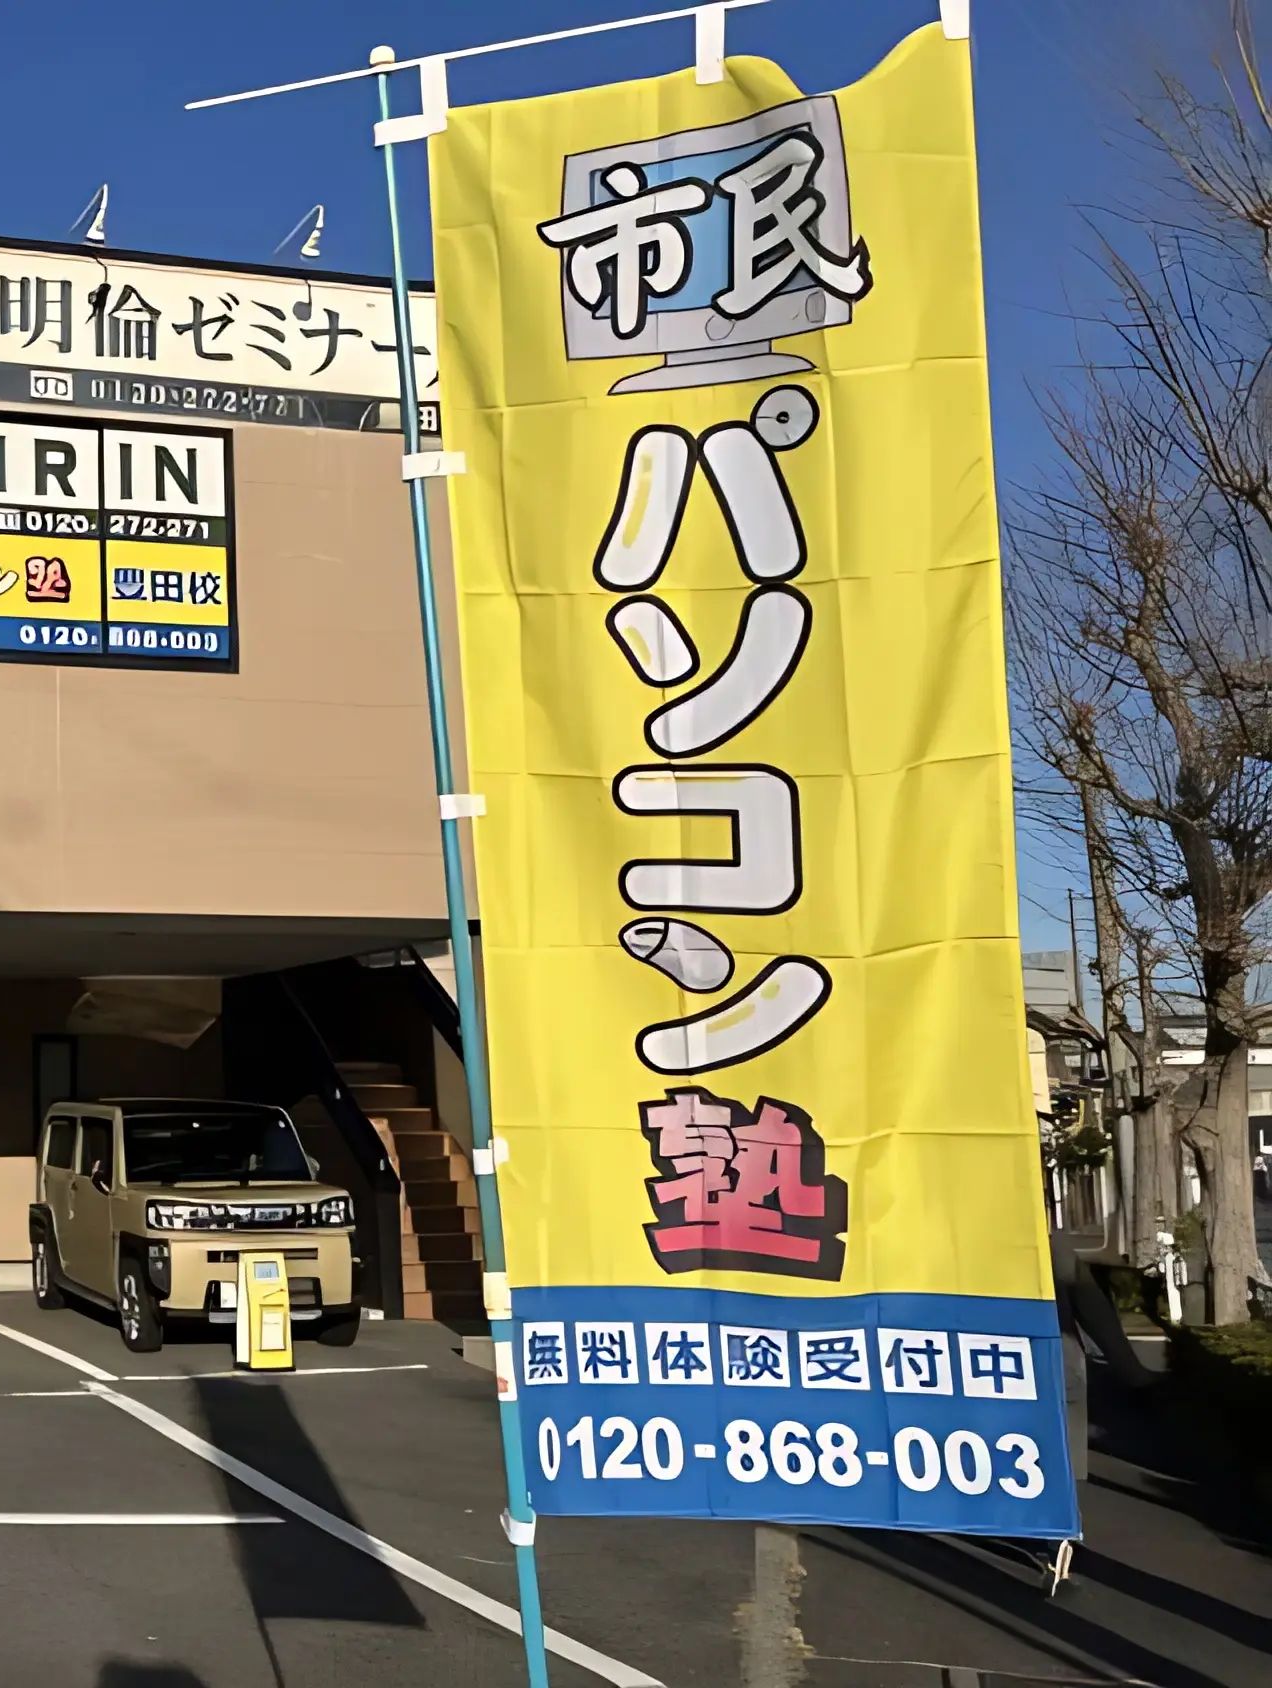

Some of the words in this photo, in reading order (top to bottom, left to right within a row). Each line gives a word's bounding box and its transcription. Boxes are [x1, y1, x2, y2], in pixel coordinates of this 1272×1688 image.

[536, 130, 874, 340] 市民
[0, 275, 439, 388] 明倫ゼミナー
[592, 384, 848, 1283] パソコン塾
[527, 1330, 1024, 1394] 無料体験受付中
[538, 1416, 1046, 1499] 0120-868-003
